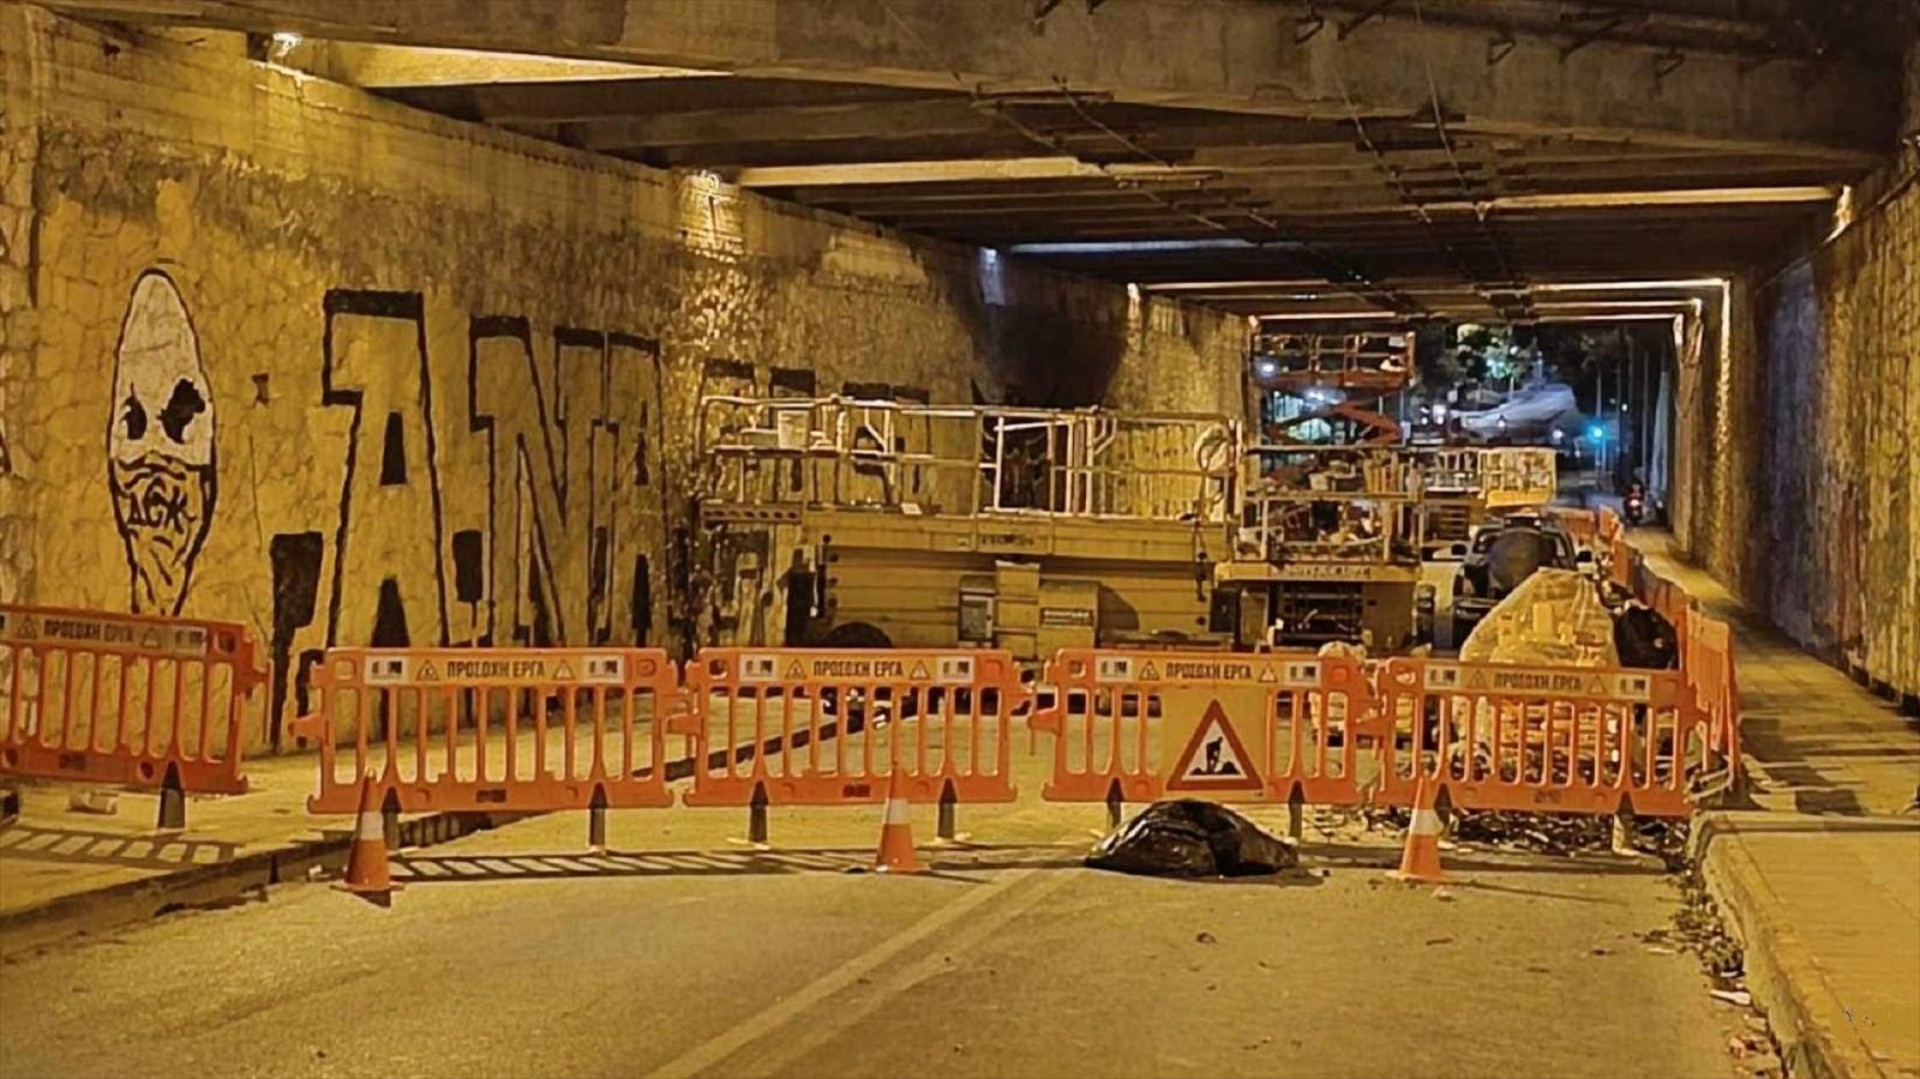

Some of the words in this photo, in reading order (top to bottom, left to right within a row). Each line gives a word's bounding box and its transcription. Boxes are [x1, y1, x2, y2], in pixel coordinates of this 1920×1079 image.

[446, 660, 509, 678] ΠΡΟΣΟΧΗ
[513, 661, 545, 678] ΕΡΓΑ
[813, 660, 871, 677] ΠΡΟΣΟΧΗ
[874, 661, 904, 677] ΕΡΓΑ
[1165, 662, 1220, 678] ΠΡΟΣΟΧΗ
[1223, 663, 1252, 679] ΕΡΓΑ
